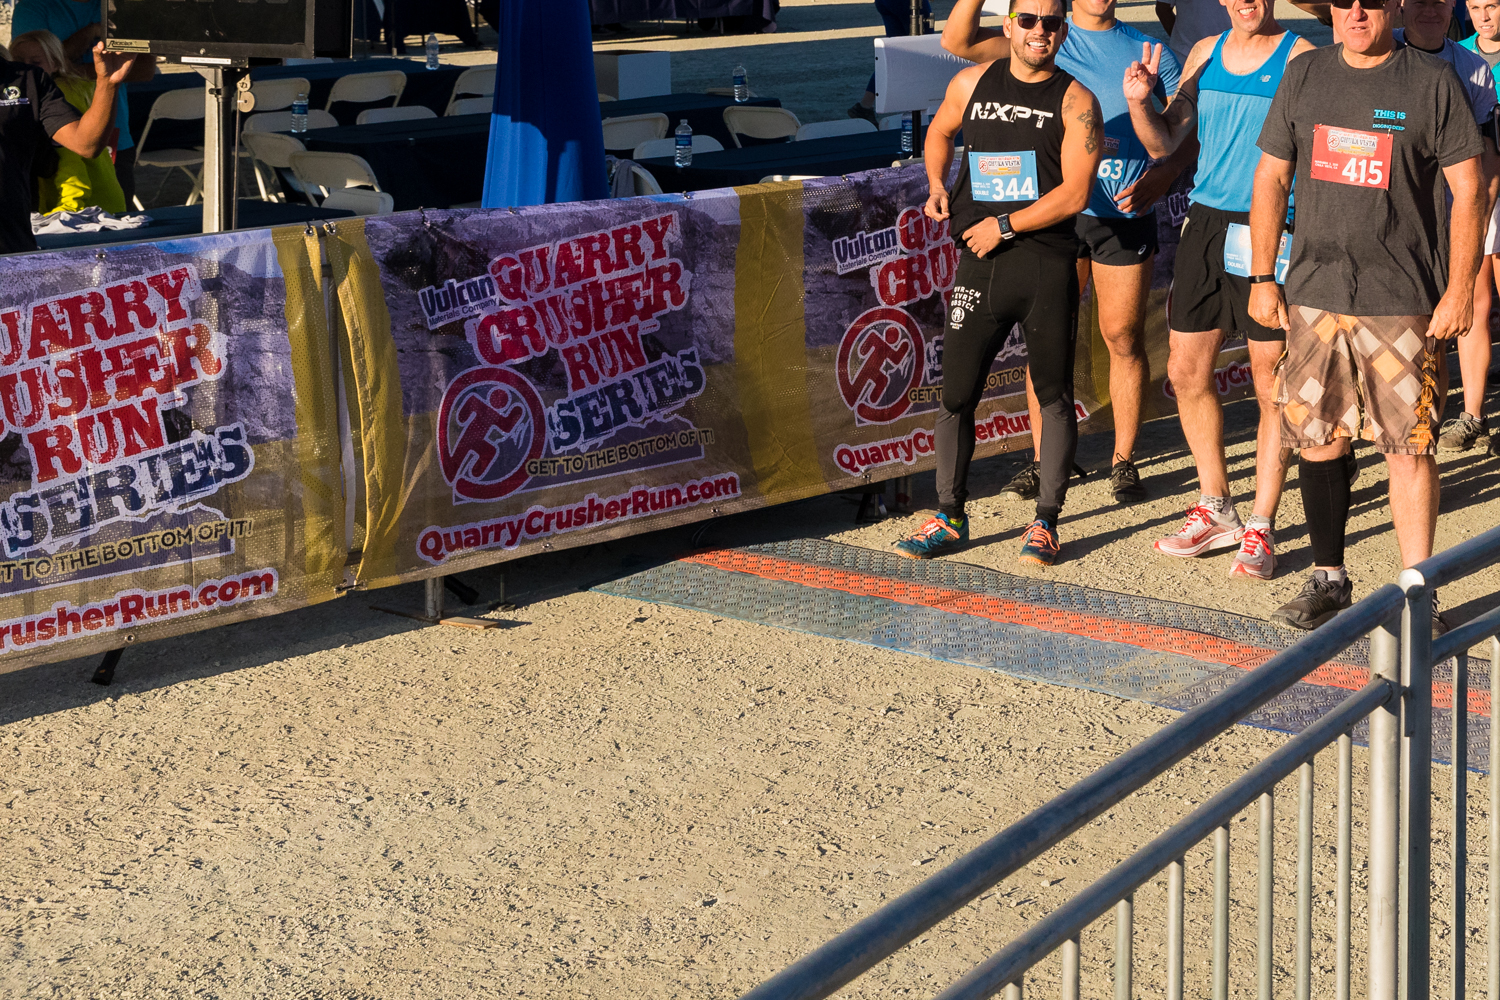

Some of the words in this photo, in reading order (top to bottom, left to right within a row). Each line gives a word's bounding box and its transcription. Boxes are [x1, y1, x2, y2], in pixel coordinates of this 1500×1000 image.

[970, 101, 1054, 129] NXPT
[1373, 109, 1396, 120] THIS
[1397, 111, 1406, 120] IS
[991, 176, 1036, 201] 344
[1341, 157, 1383, 186] 415
[491, 214, 675, 301] QUARRY
[834, 226, 898, 264] Vulcan
[0, 267, 188, 367] UARRY
[419, 275, 496, 316] Vulcan
[476, 262, 686, 365] CRUSHER
[0, 322, 222, 438] USHER
[561, 325, 648, 391] RUN
[550, 353, 704, 450] SERIES
[908, 387, 930, 403] GET
[27, 397, 165, 483] RUN
[526, 458, 562, 478] GET
[562, 455, 585, 474] TO
[585, 449, 618, 469] THE
[618, 434, 678, 461] BOTTOM
[678, 432, 698, 449] OF
[698, 427, 716, 446] IT!
[0, 430, 252, 555] SERIES
[418, 474, 738, 561] QuarryCrusherRun.com
[22, 559, 51, 579] TO
[55, 549, 98, 573] THE
[102, 527, 193, 562] BOTTOM
[199, 522, 226, 541] OF
[226, 519, 254, 539] IT!
[0, 572, 275, 651] rusherRun.com
